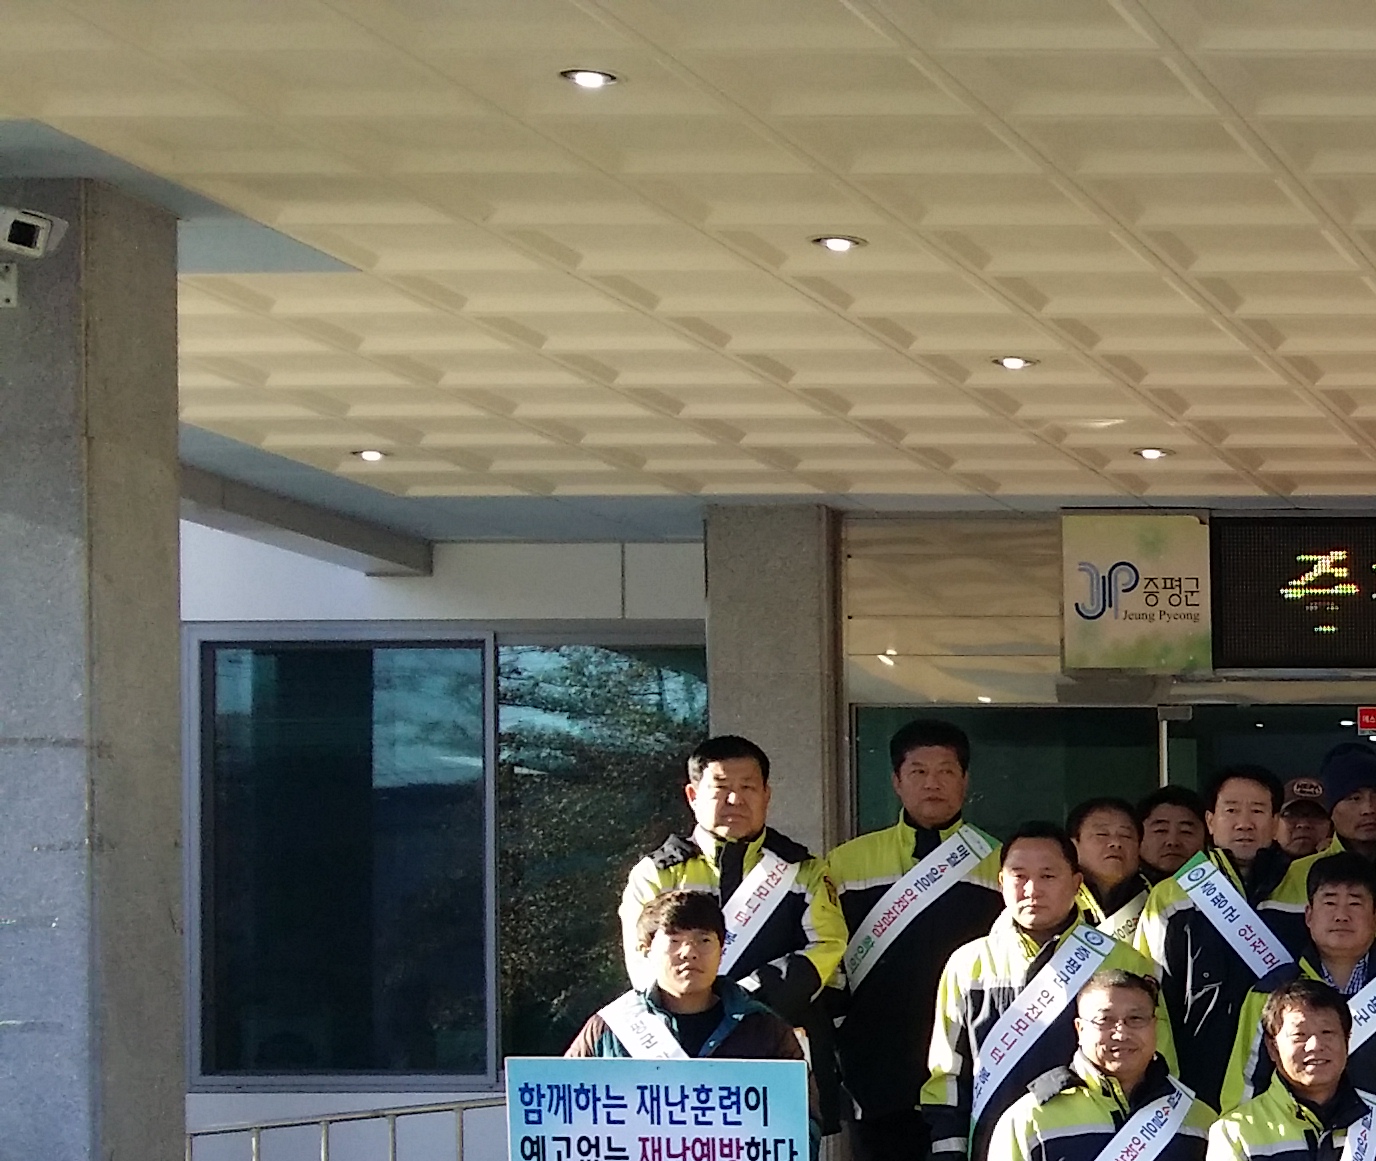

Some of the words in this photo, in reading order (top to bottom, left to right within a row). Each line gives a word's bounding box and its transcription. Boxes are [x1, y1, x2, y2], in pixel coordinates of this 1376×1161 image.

[1143, 576, 1199, 607] 증평군
[1123, 609, 1155, 623] Jeung
[1159, 609, 1200, 623] Pyeong
[945, 844, 969, 868] 매월
[913, 862, 948, 892] 4일은
[871, 887, 917, 937] 안전점검
[1201, 880, 1239, 923] 증평군
[1237, 923, 1279, 969] 안전모
[1052, 945, 1090, 988] 증평군
[987, 989, 1054, 1064] 안전모니터
[518, 1082, 628, 1125] 함께하는
[636, 1084, 768, 1126] 재난훈련이
[1138, 1104, 1171, 1141] 4일은
